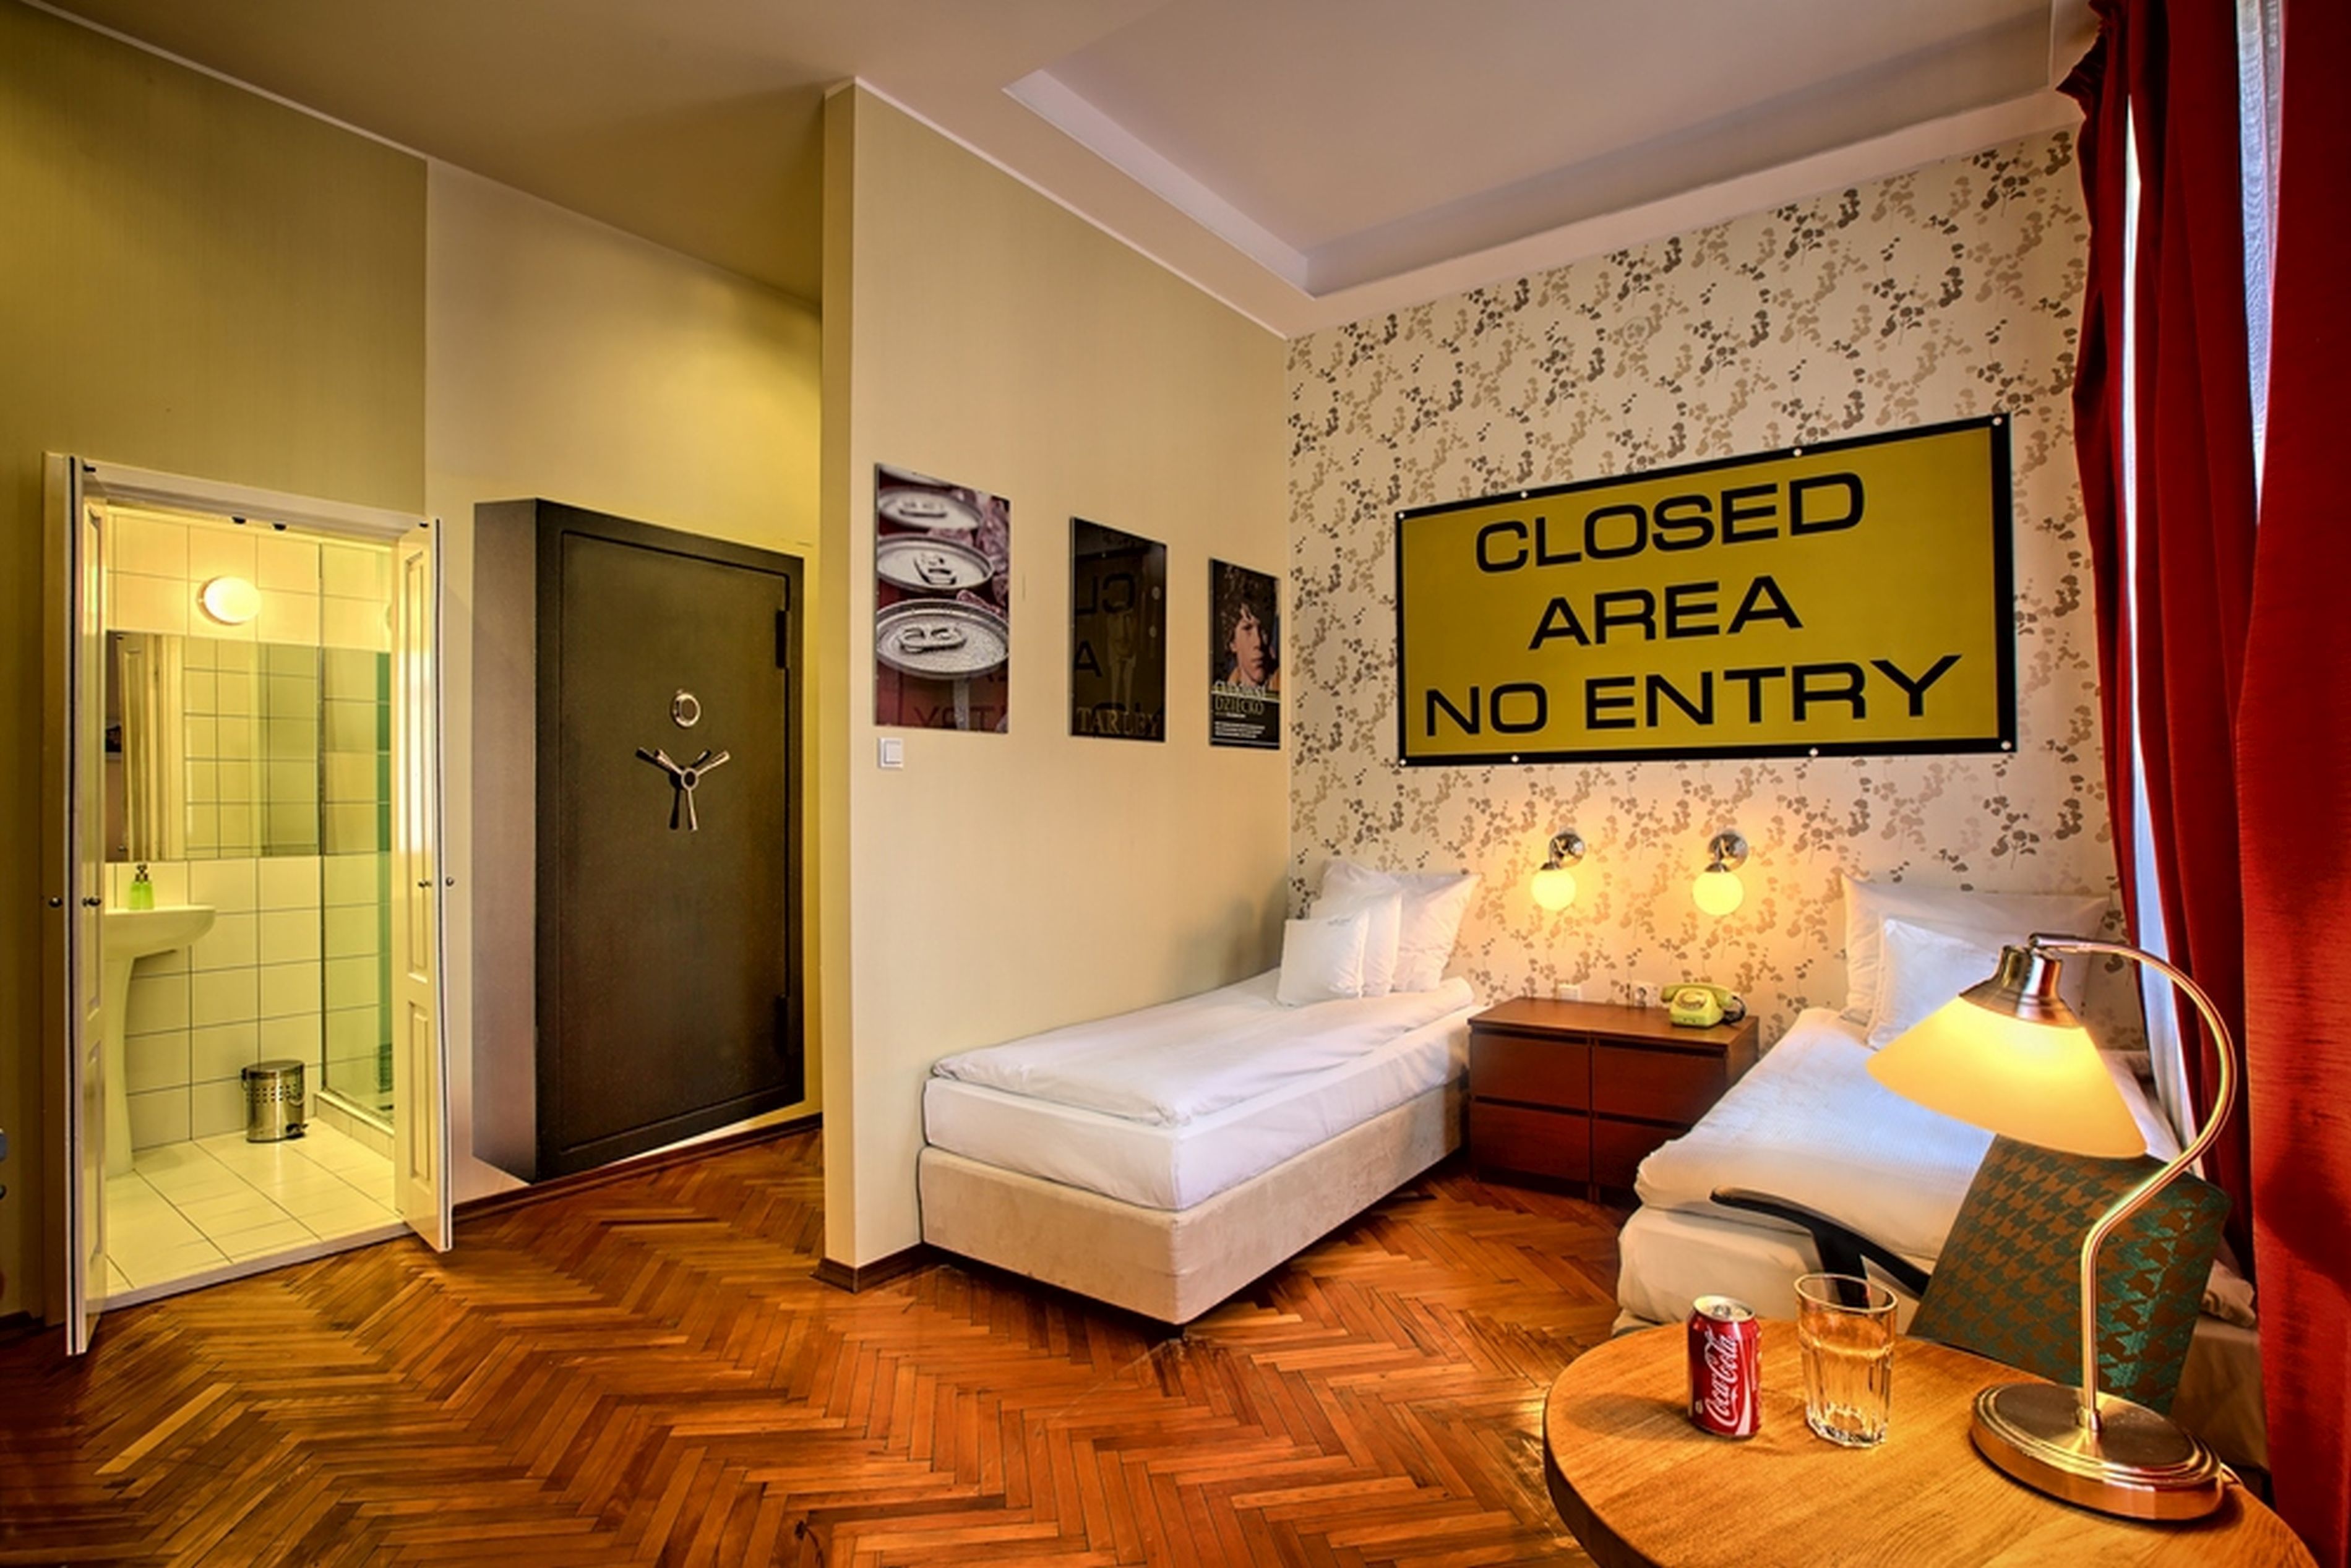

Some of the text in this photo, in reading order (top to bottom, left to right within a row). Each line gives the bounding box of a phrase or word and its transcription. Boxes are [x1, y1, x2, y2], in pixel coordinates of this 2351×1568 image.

[1476, 471, 1865, 573] CLOSED
[1528, 575, 1803, 650] AREA
[1426, 654, 1962, 737] NO ENTRY
